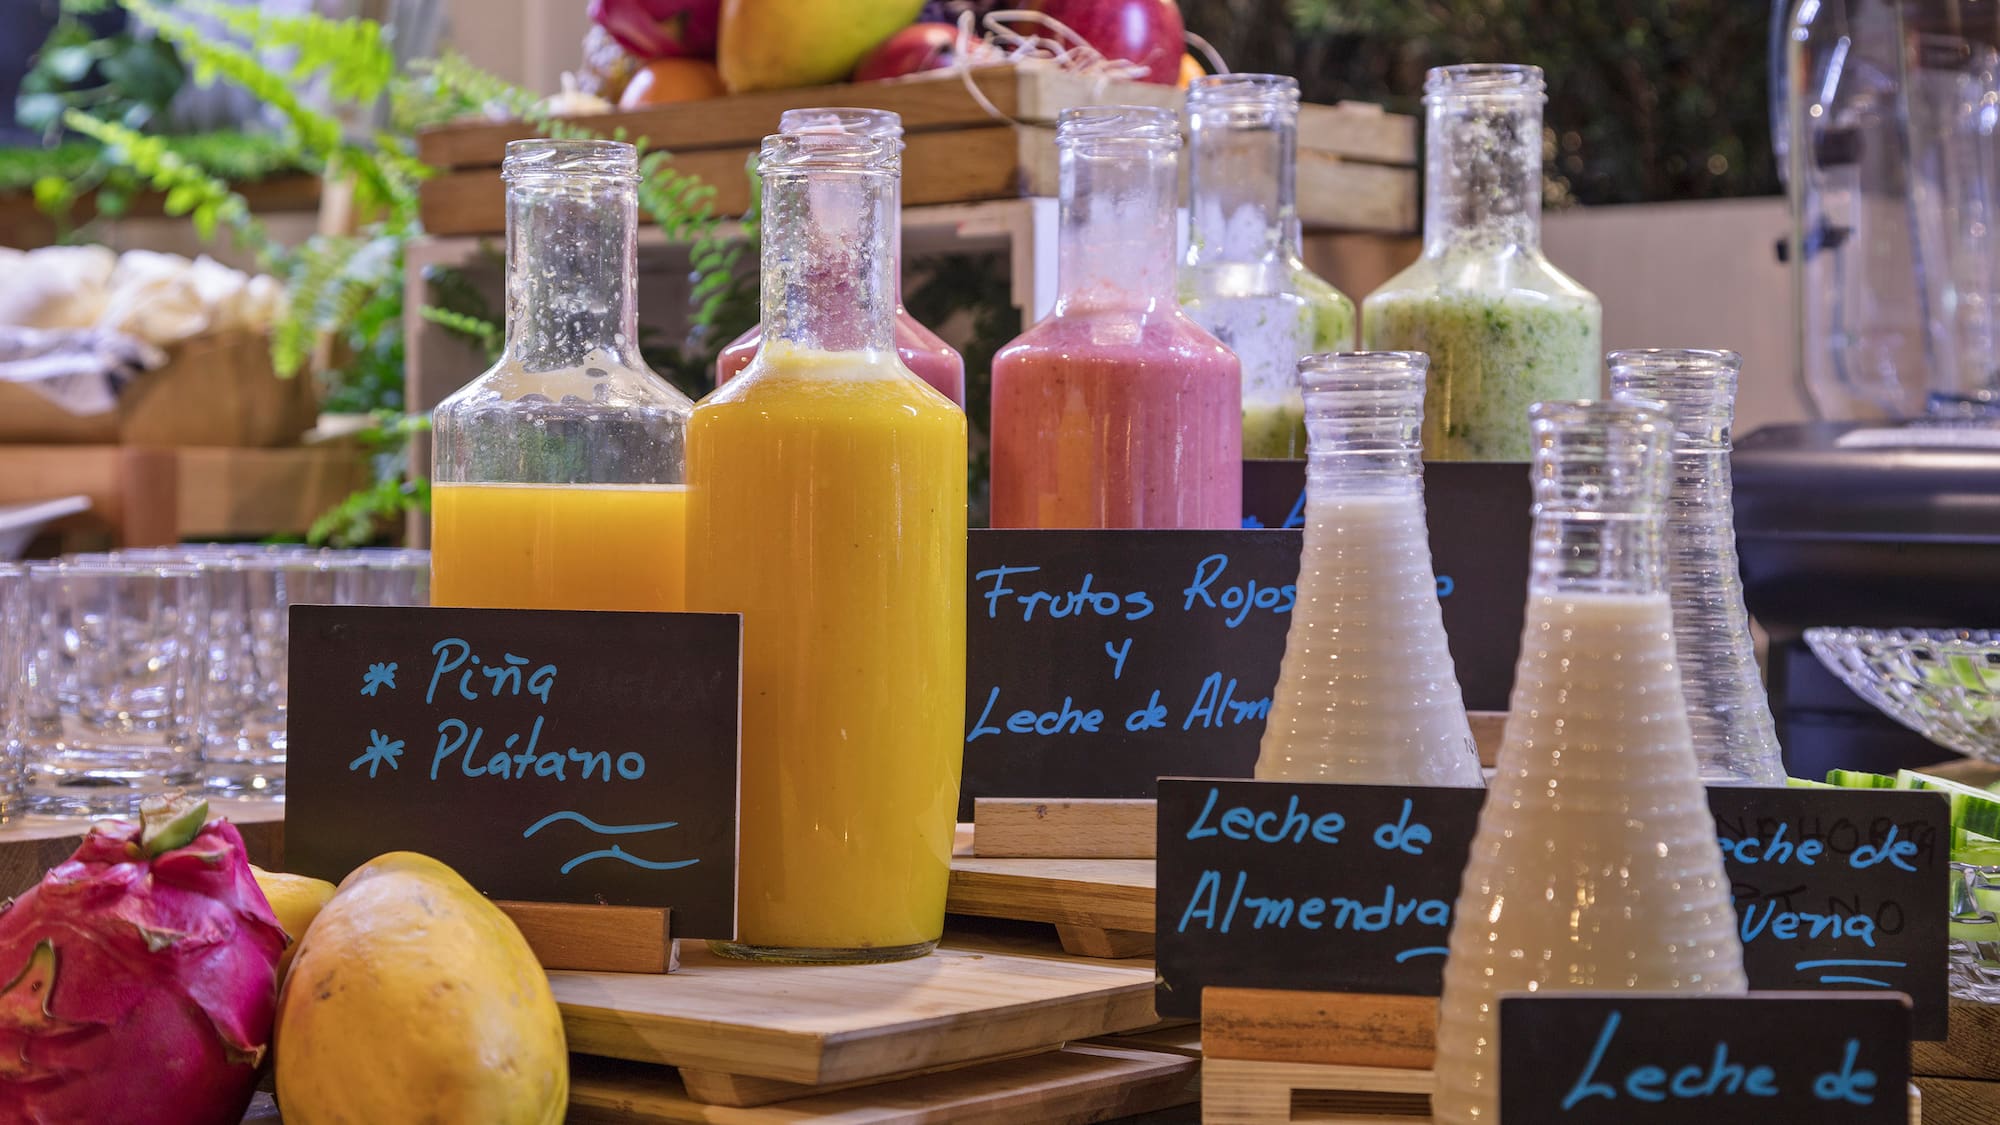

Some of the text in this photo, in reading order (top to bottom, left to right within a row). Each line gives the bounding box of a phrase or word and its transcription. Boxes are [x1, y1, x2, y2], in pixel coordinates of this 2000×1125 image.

[975, 553, 1297, 629] Frutos Rojos
[426, 638, 557, 704] Piña
[966, 671, 1273, 743] Leche de Alm
[430, 716, 645, 782] Plátano
[1186, 788, 1432, 855] Leche de
[1716, 822, 1918, 872] eche de
[1177, 870, 1450, 934] Almendra
[1740, 899, 1876, 948] Vena
[1563, 1012, 1876, 1109] Leche de
